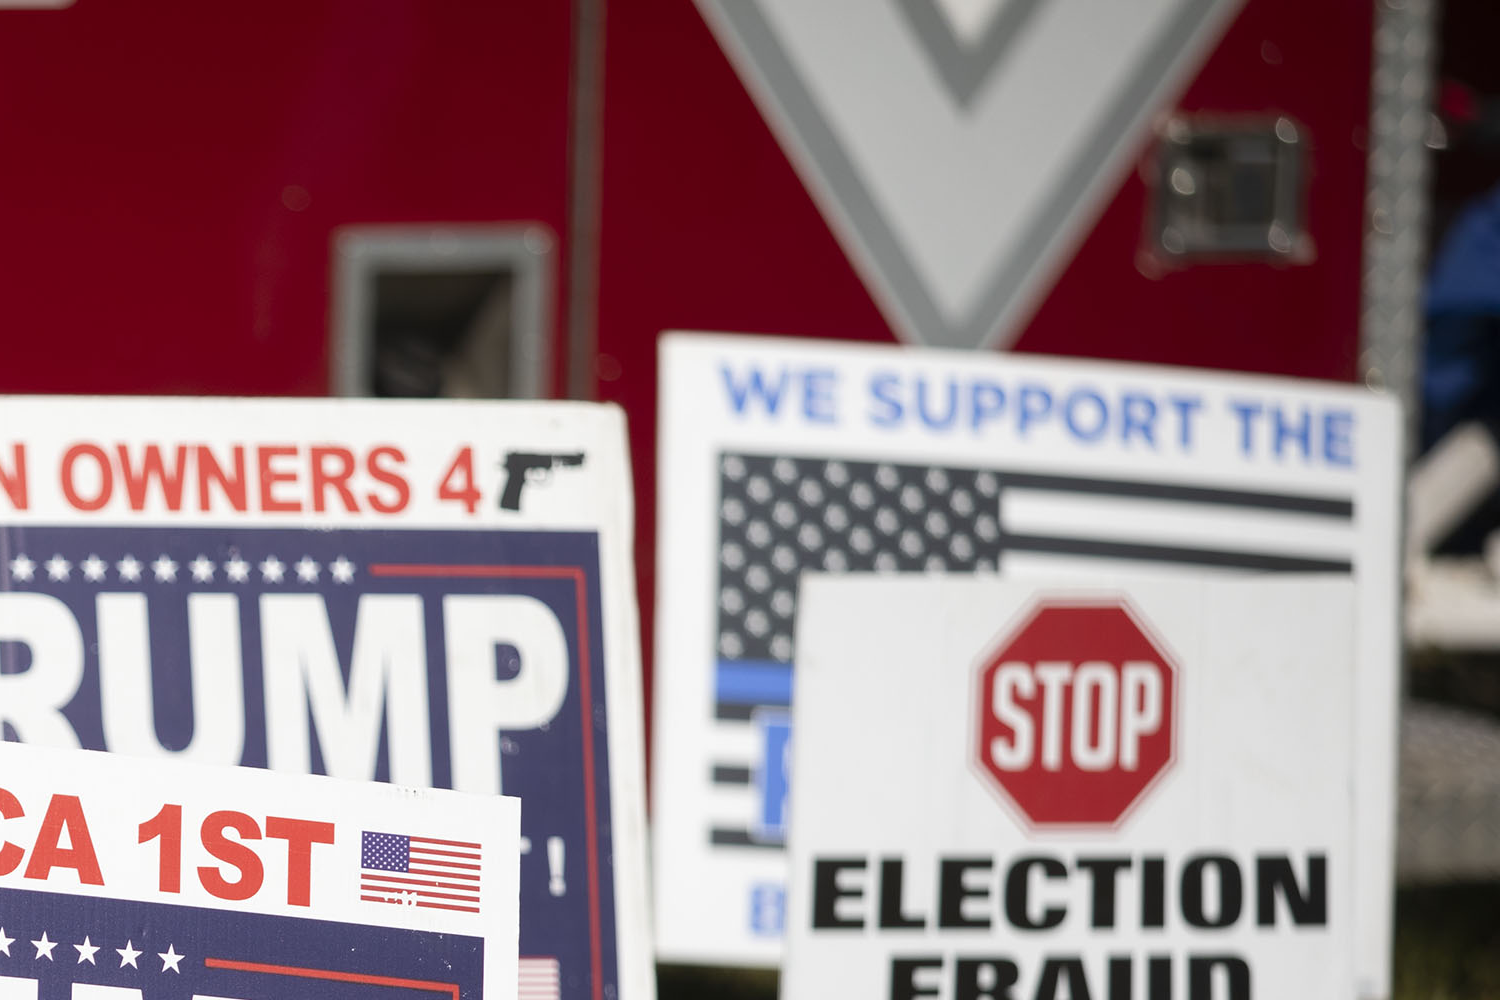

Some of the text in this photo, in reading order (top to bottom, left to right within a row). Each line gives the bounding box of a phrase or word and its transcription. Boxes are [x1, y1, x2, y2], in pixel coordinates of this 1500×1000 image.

[720, 362, 1357, 468] WE SUPPORT THE
[59, 443, 411, 515] OWNERS
[437, 447, 483, 514] 4
[990, 660, 1164, 771] STOP
[137, 803, 335, 908] 1ST
[810, 853, 1329, 932] ELECTION
